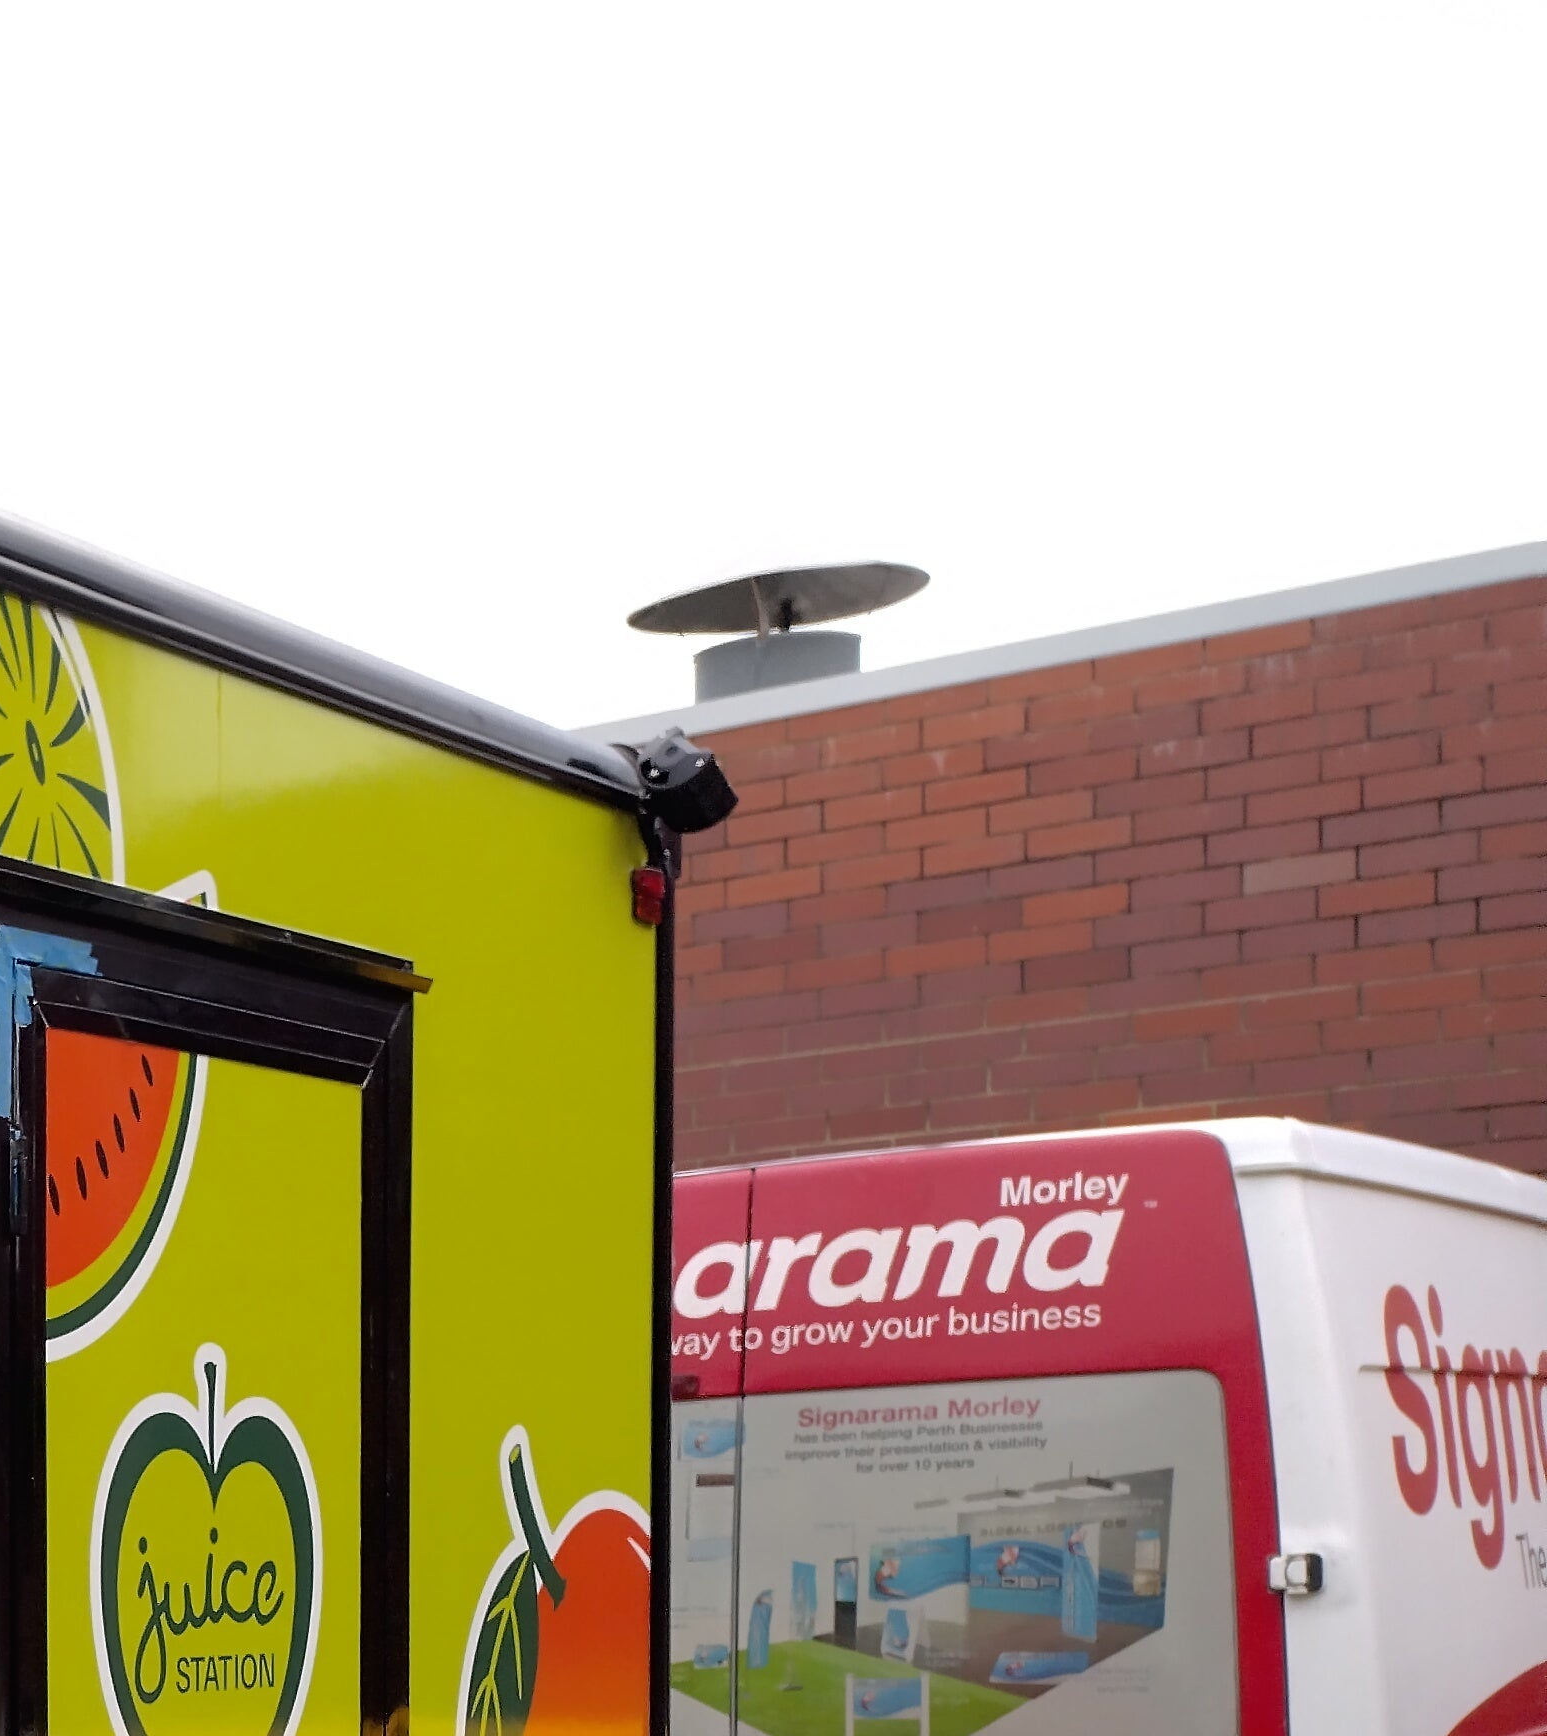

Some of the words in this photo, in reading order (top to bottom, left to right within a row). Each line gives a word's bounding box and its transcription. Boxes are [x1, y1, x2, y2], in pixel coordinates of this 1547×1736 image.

[1000, 1171, 1129, 1208] Morley
[728, 1324, 764, 1353] to
[771, 1318, 854, 1354] grow
[861, 1312, 940, 1349] your
[948, 1301, 1102, 1337] business
[798, 1404, 938, 1430] Signarama
[947, 1396, 1041, 1420] Morley
[784, 1447, 840, 1462] improve
[845, 1445, 875, 1459] their
[879, 1440, 969, 1458] presentation
[988, 1436, 1048, 1451] visibility
[794, 1432, 818, 1444] has
[822, 1429, 857, 1442] been
[861, 1426, 912, 1441] helping
[917, 1423, 955, 1436] Perth
[856, 1462, 874, 1474] for
[879, 1460, 909, 1473] over
[936, 1457, 975, 1472] years
[134, 1527, 285, 1704] juice
[175, 1652, 276, 1695] STATION
